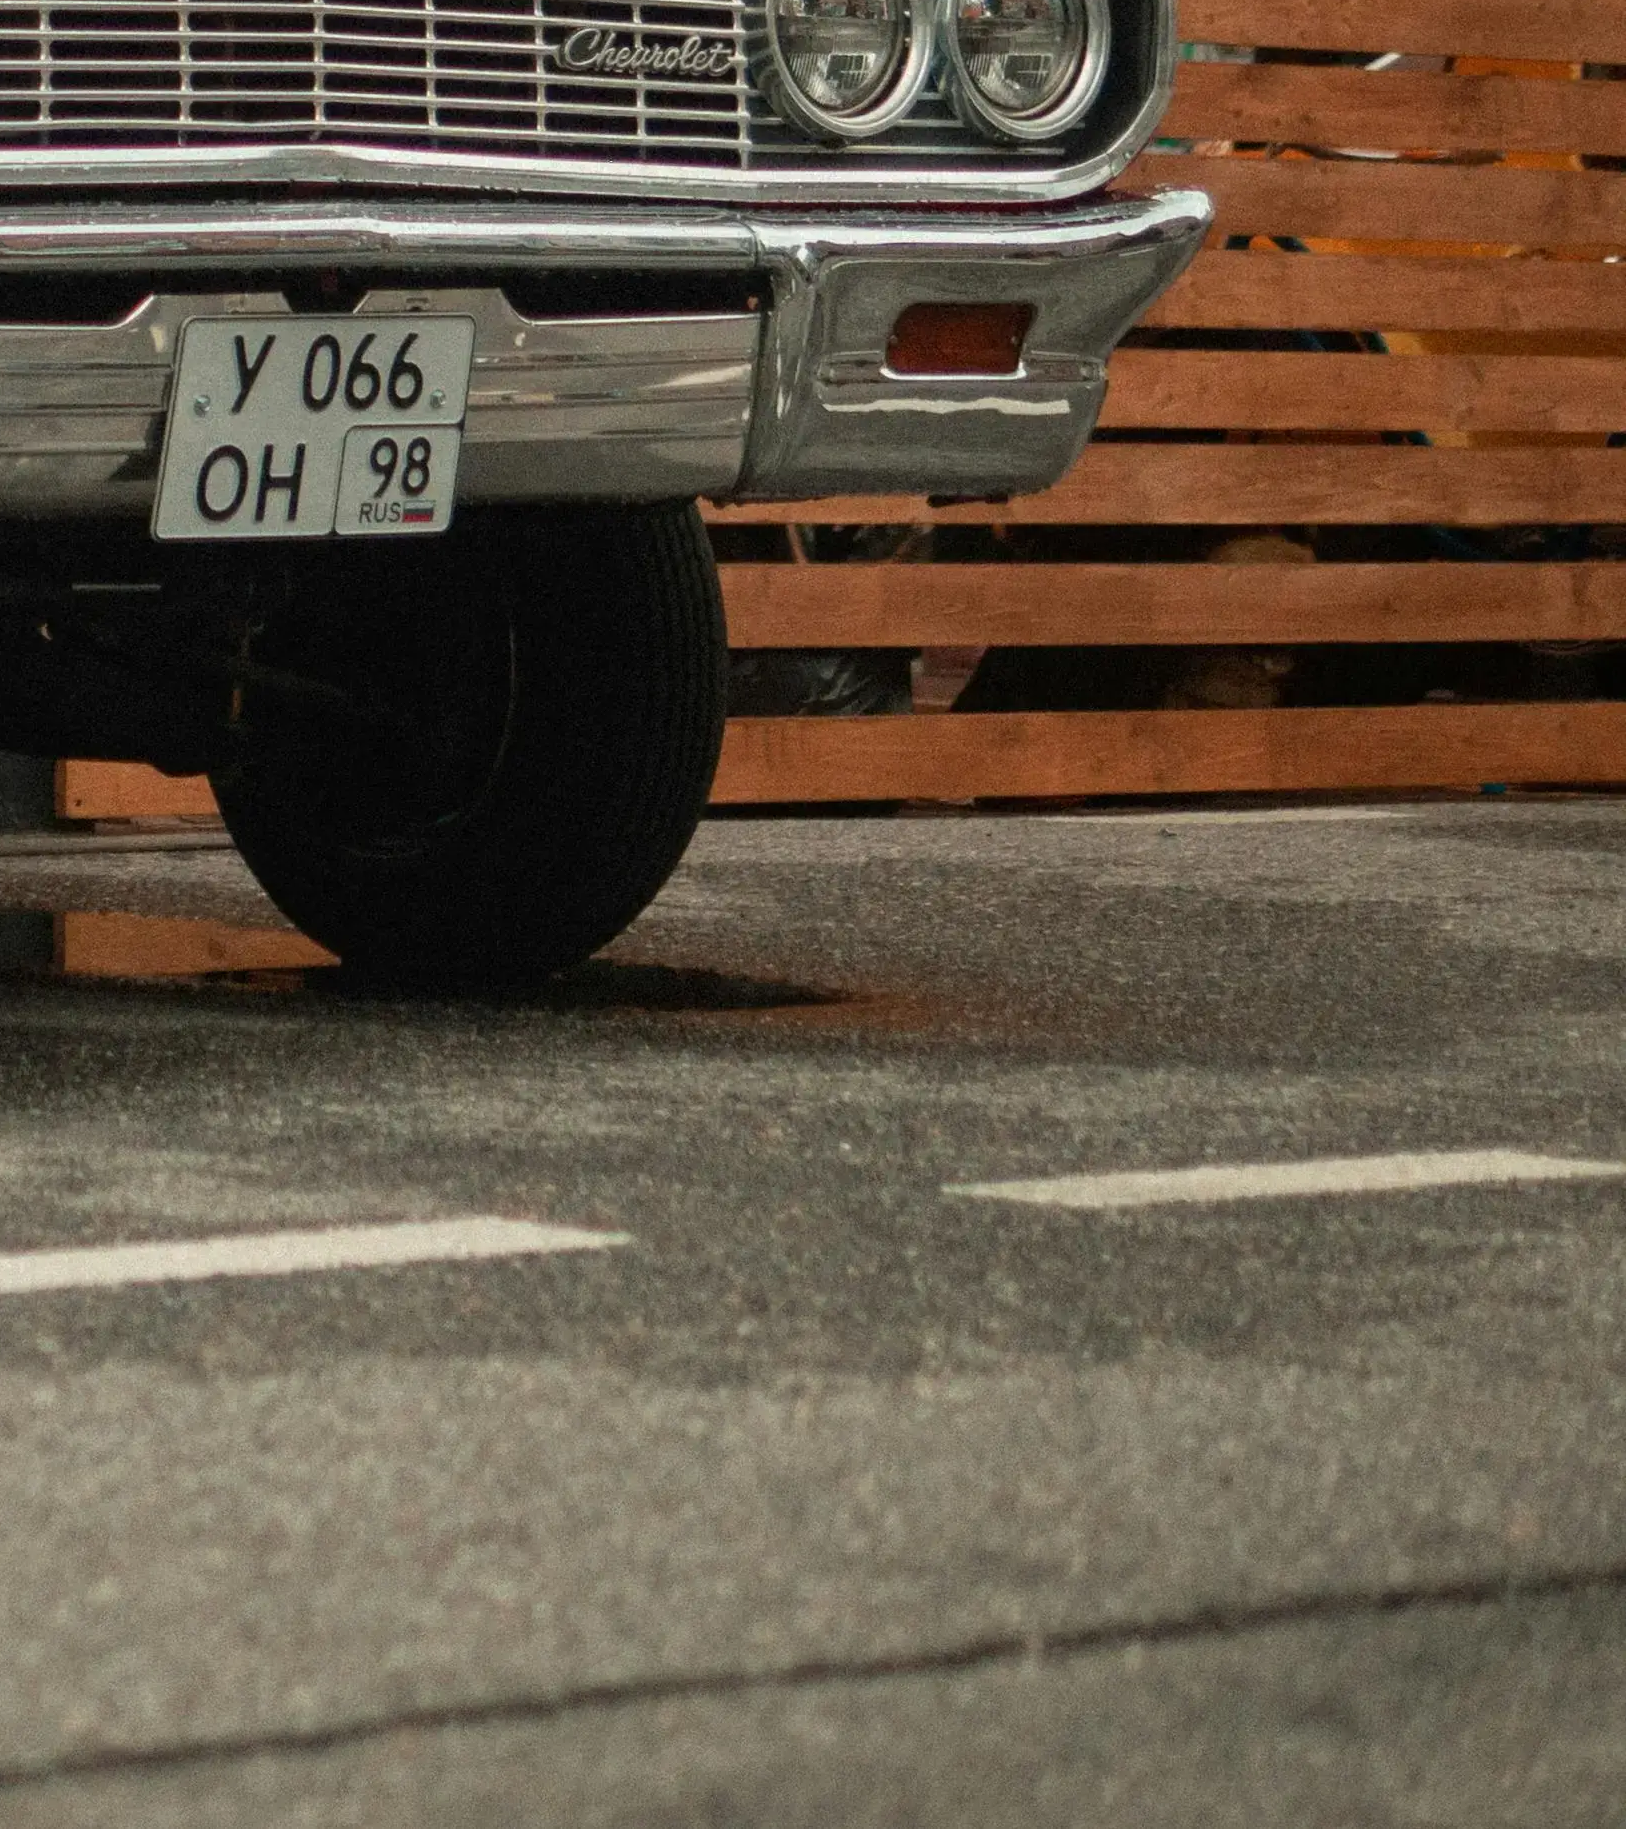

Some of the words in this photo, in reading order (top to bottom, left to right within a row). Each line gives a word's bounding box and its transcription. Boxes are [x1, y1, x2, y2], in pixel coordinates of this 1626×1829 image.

[562, 27, 734, 77] Chevrolet
[301, 332, 424, 413] 066
[369, 436, 432, 499] 98
[358, 499, 401, 524] RUS
